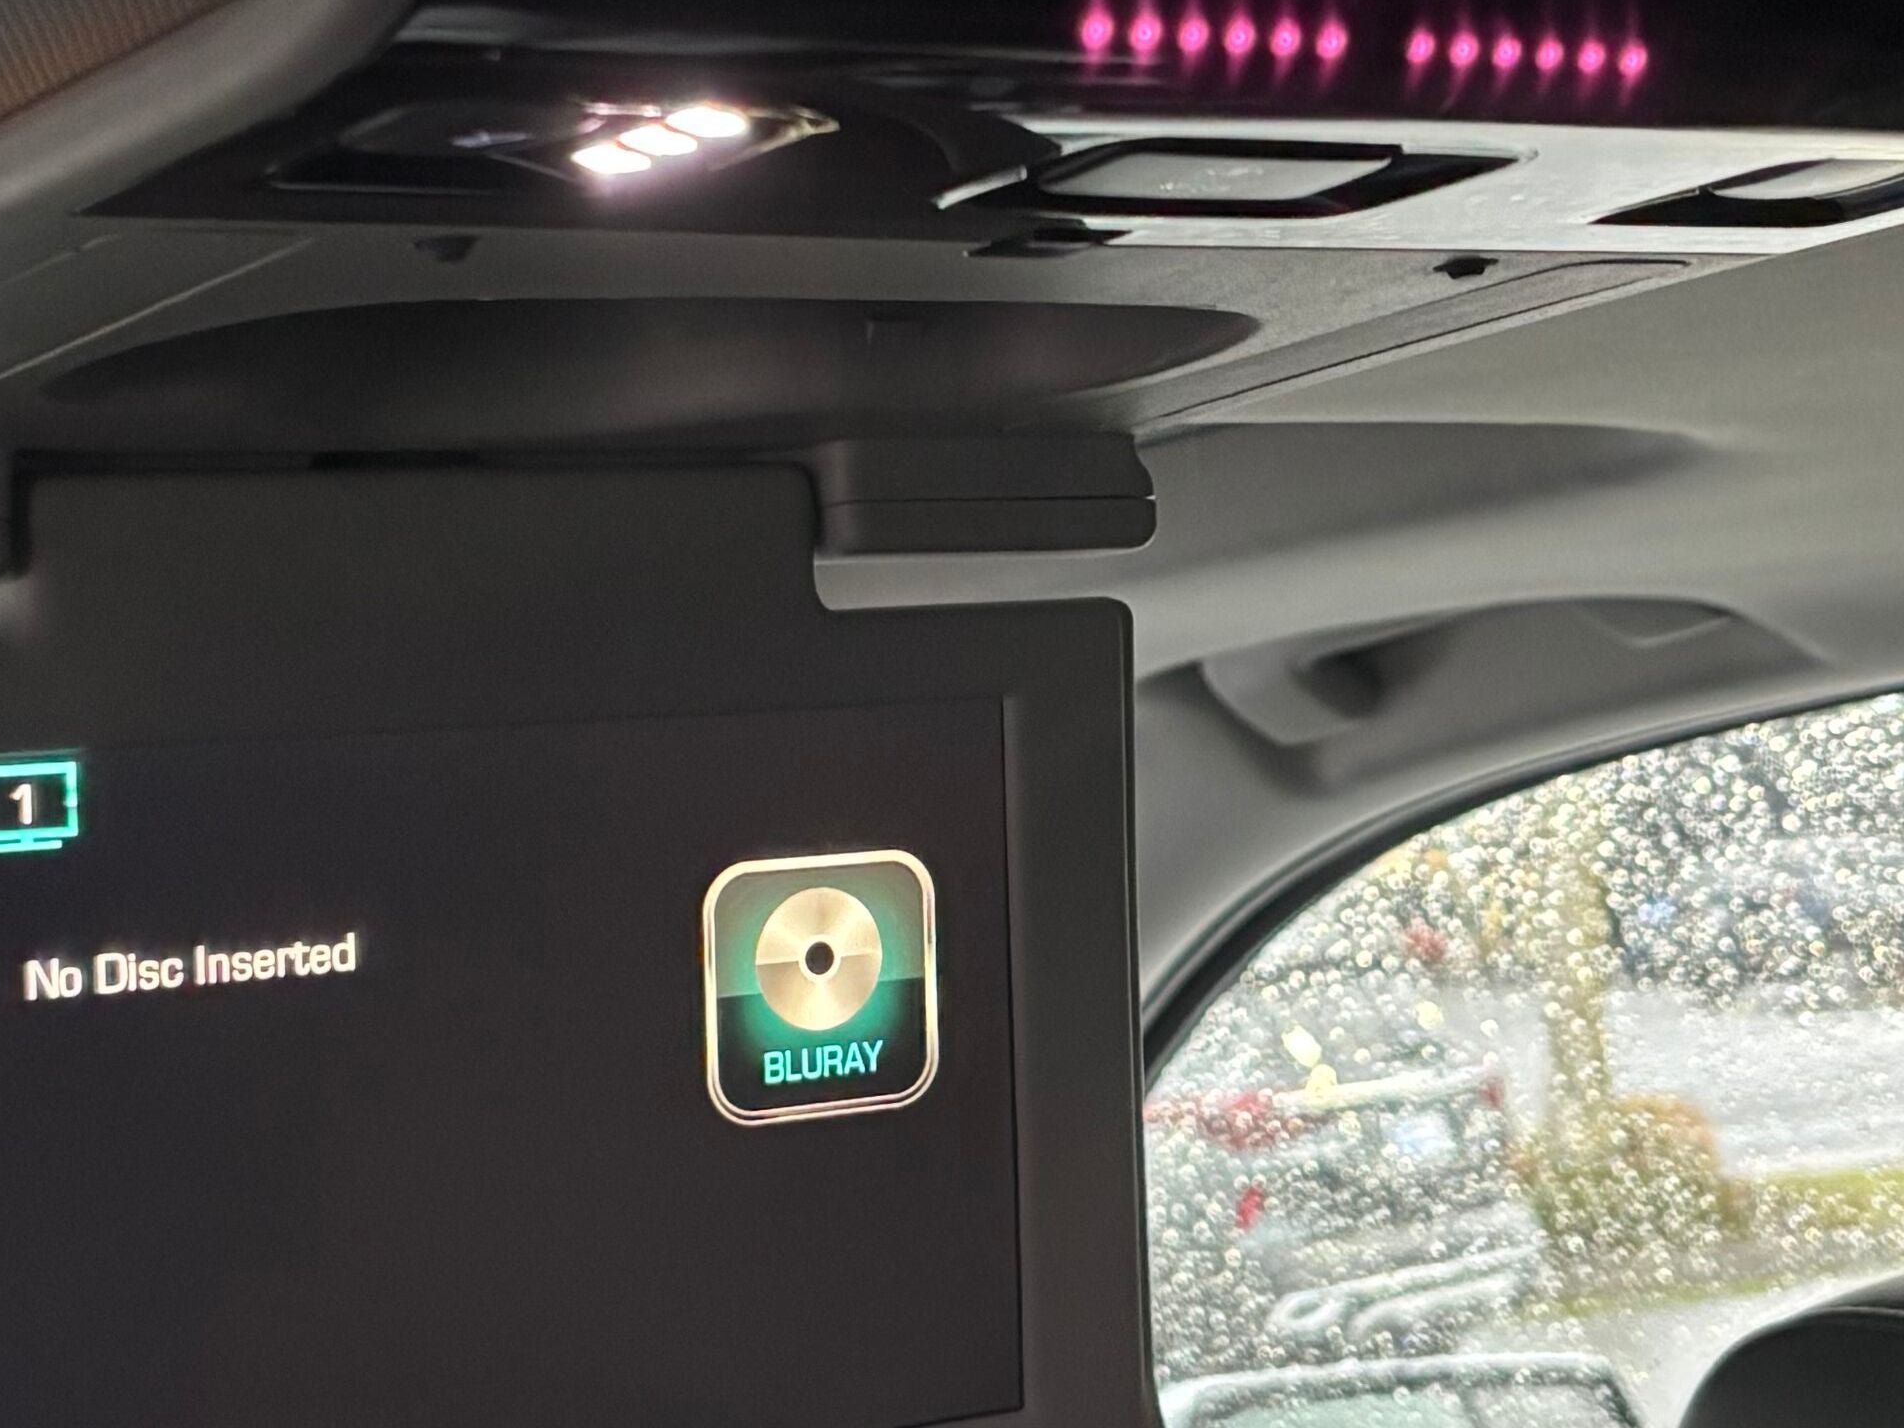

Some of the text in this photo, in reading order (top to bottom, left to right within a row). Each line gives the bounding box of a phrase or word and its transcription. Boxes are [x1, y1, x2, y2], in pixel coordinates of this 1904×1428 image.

[8, 783, 33, 825] 1
[22, 957, 84, 1001] No
[94, 951, 184, 995] Disc
[195, 932, 358, 985] Inserted
[764, 1039, 883, 1084] BLURAY
